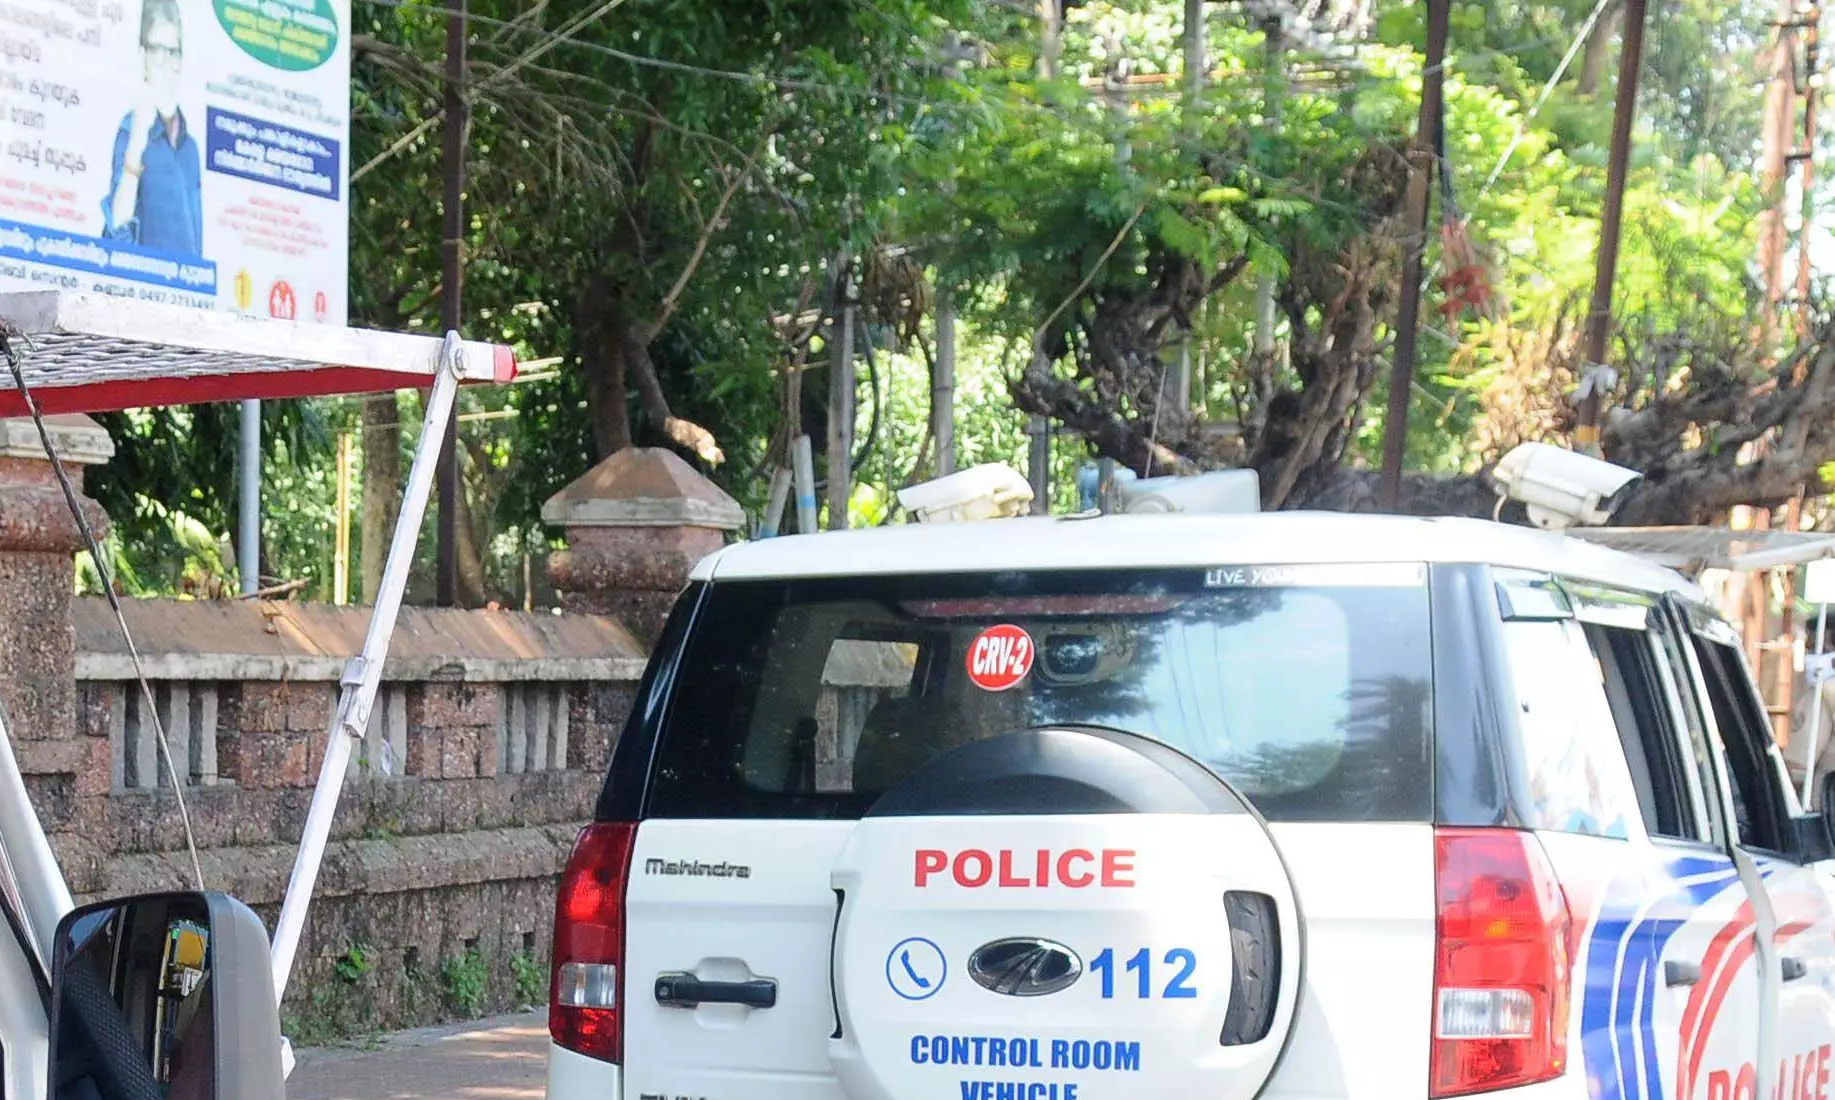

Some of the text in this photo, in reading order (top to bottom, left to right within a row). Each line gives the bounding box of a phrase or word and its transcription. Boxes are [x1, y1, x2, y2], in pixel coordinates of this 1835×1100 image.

[1206, 569, 1247, 585] LIVE
[972, 635, 1029, 676] CRV-2
[645, 858, 752, 879] Mahindra
[914, 849, 1136, 888] POLICE
[1089, 948, 1198, 999] 112
[910, 1034, 1141, 1071] CONTROL ROOM
